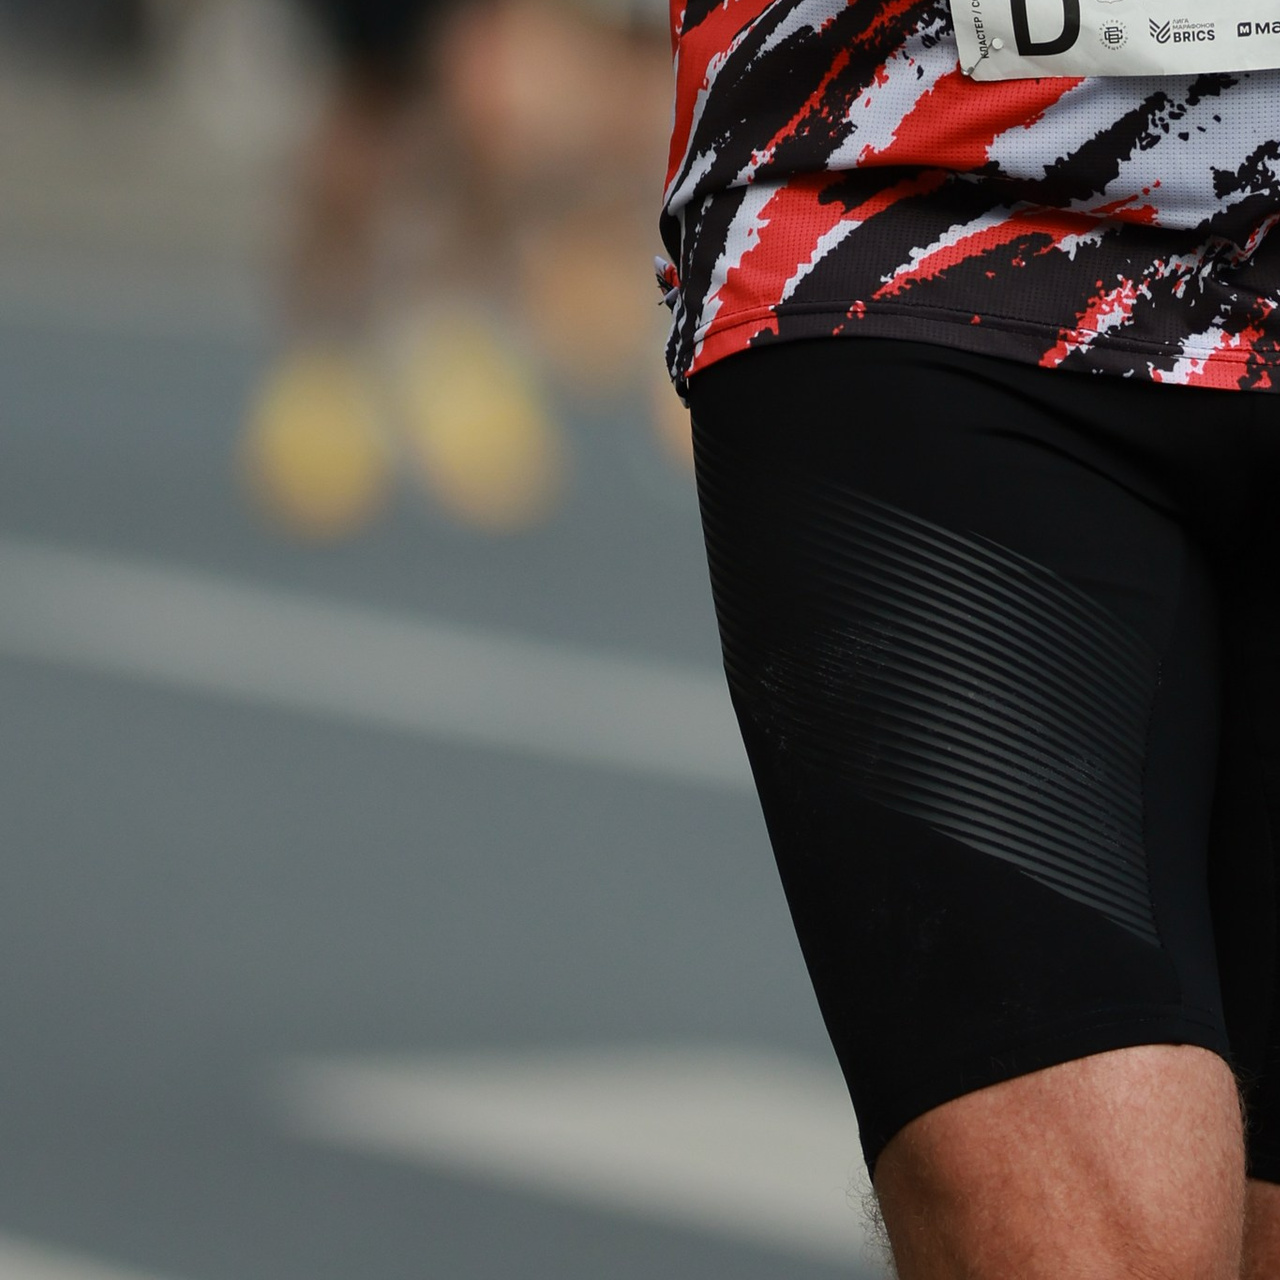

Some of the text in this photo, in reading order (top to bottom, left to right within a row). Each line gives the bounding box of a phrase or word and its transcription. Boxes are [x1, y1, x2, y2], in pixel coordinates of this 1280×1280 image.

[1172, 22, 1215, 30] МАРАФОНОВ
[973, 16, 990, 59] КЛАСТЕР
[1173, 29, 1215, 43] BRICS
